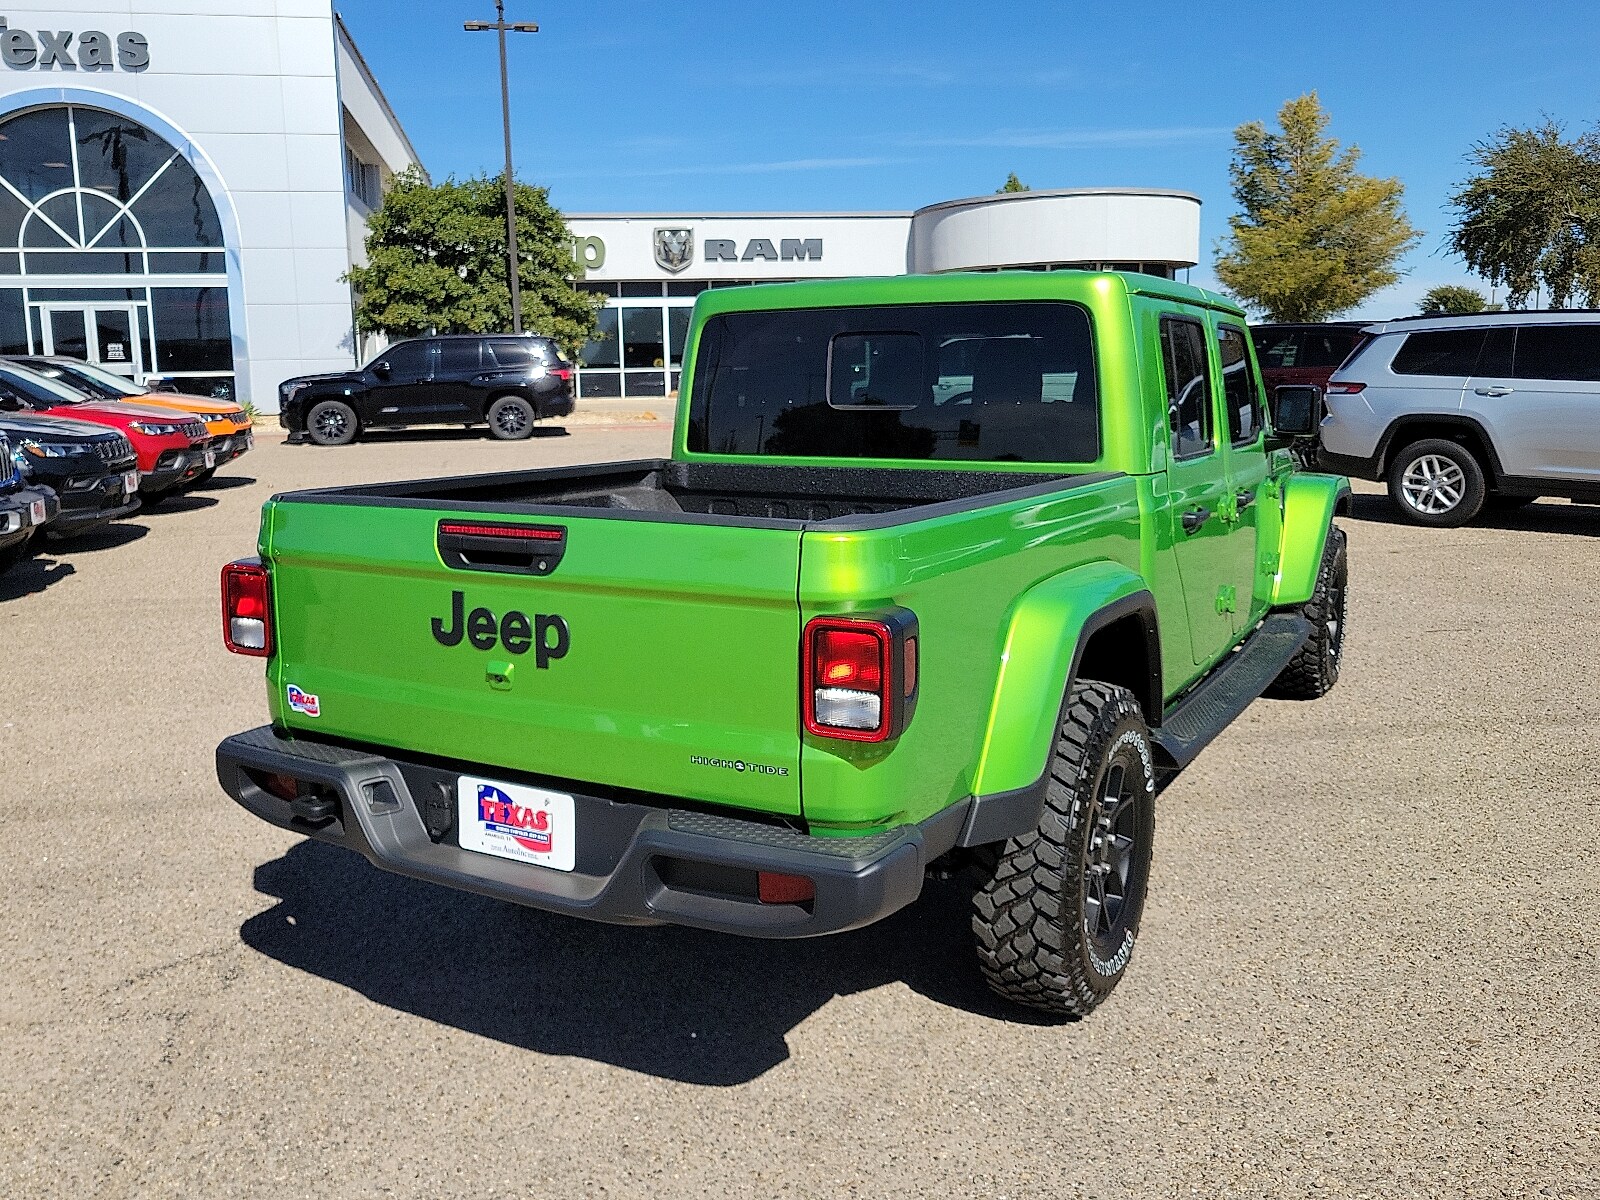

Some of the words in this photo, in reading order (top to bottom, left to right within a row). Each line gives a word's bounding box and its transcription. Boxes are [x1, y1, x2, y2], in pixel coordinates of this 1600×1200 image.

[0, 15, 150, 73] exas
[704, 238, 823, 262] RAM
[431, 590, 570, 669] Jeep
[746, 762, 789, 776] TIDE
[480, 798, 548, 831] TEXAS
